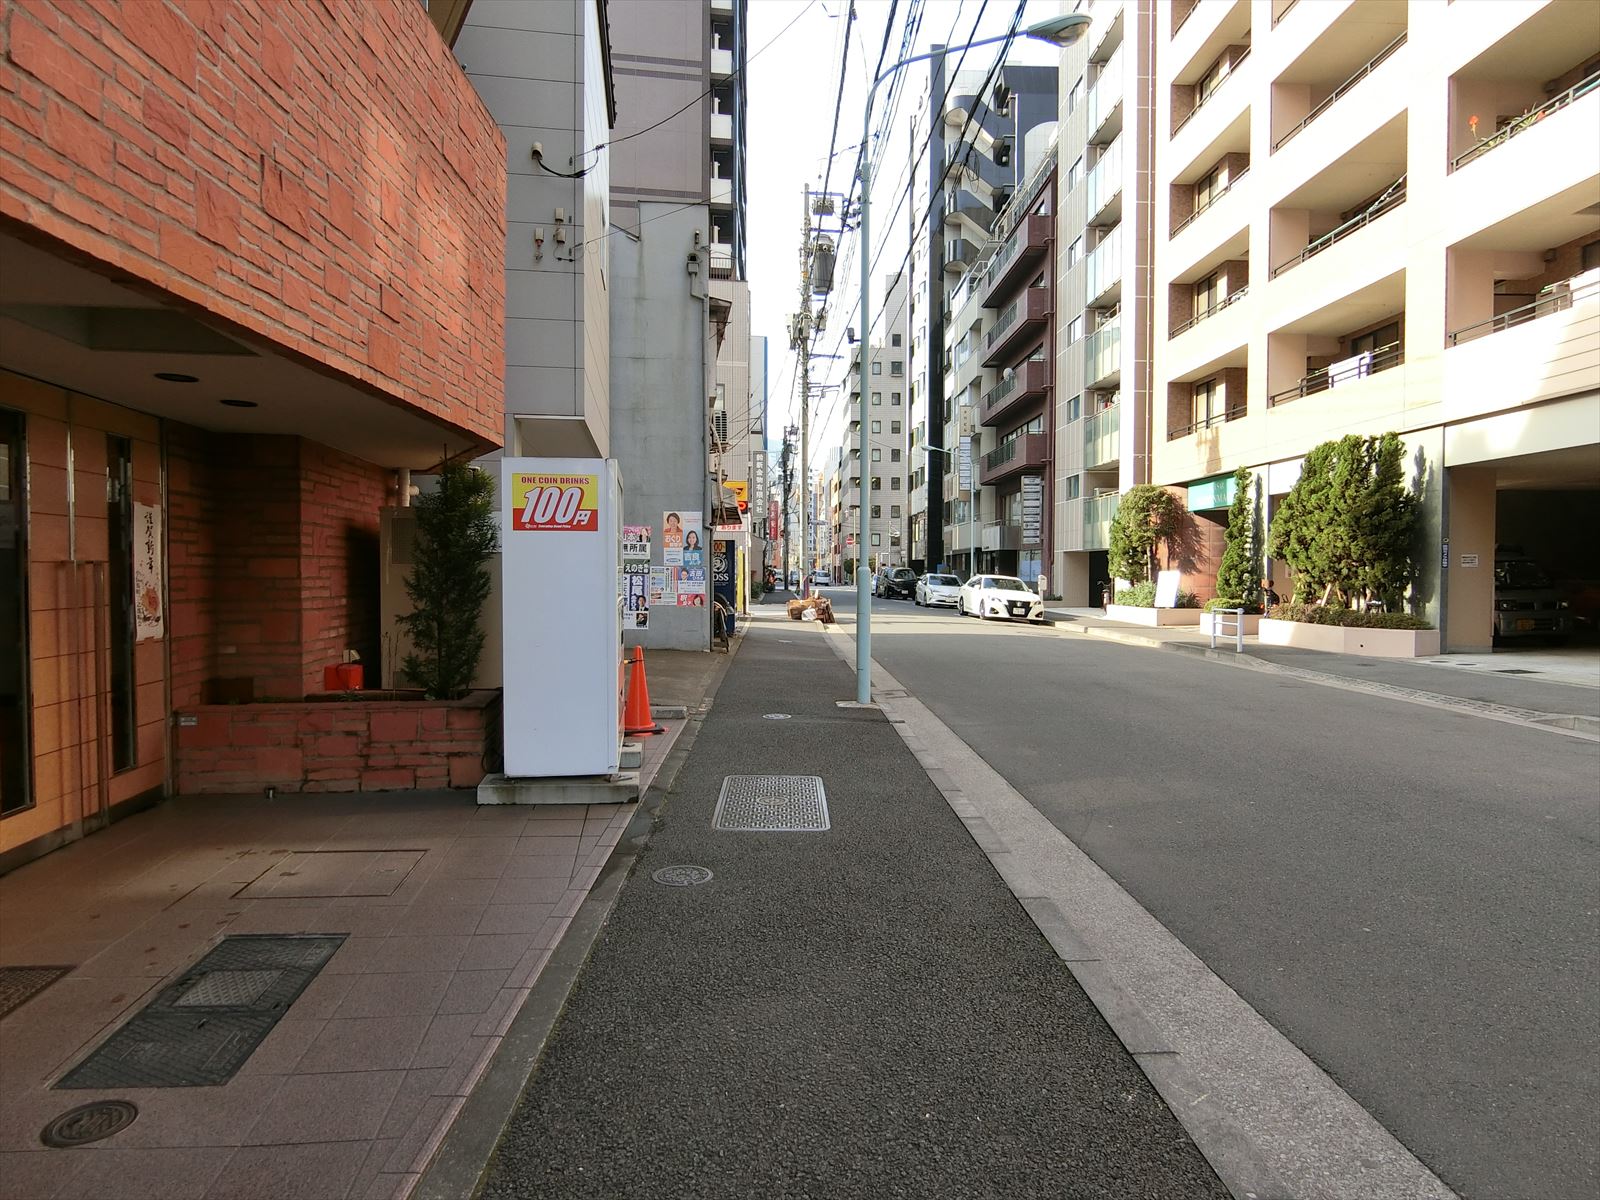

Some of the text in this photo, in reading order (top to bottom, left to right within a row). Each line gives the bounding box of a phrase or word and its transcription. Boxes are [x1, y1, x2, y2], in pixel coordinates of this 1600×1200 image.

[538, 477, 558, 485] COIN
[560, 477, 590, 485] DRINKS
[625, 563, 643, 573] えのき
[712, 572, 729, 582] OSS
